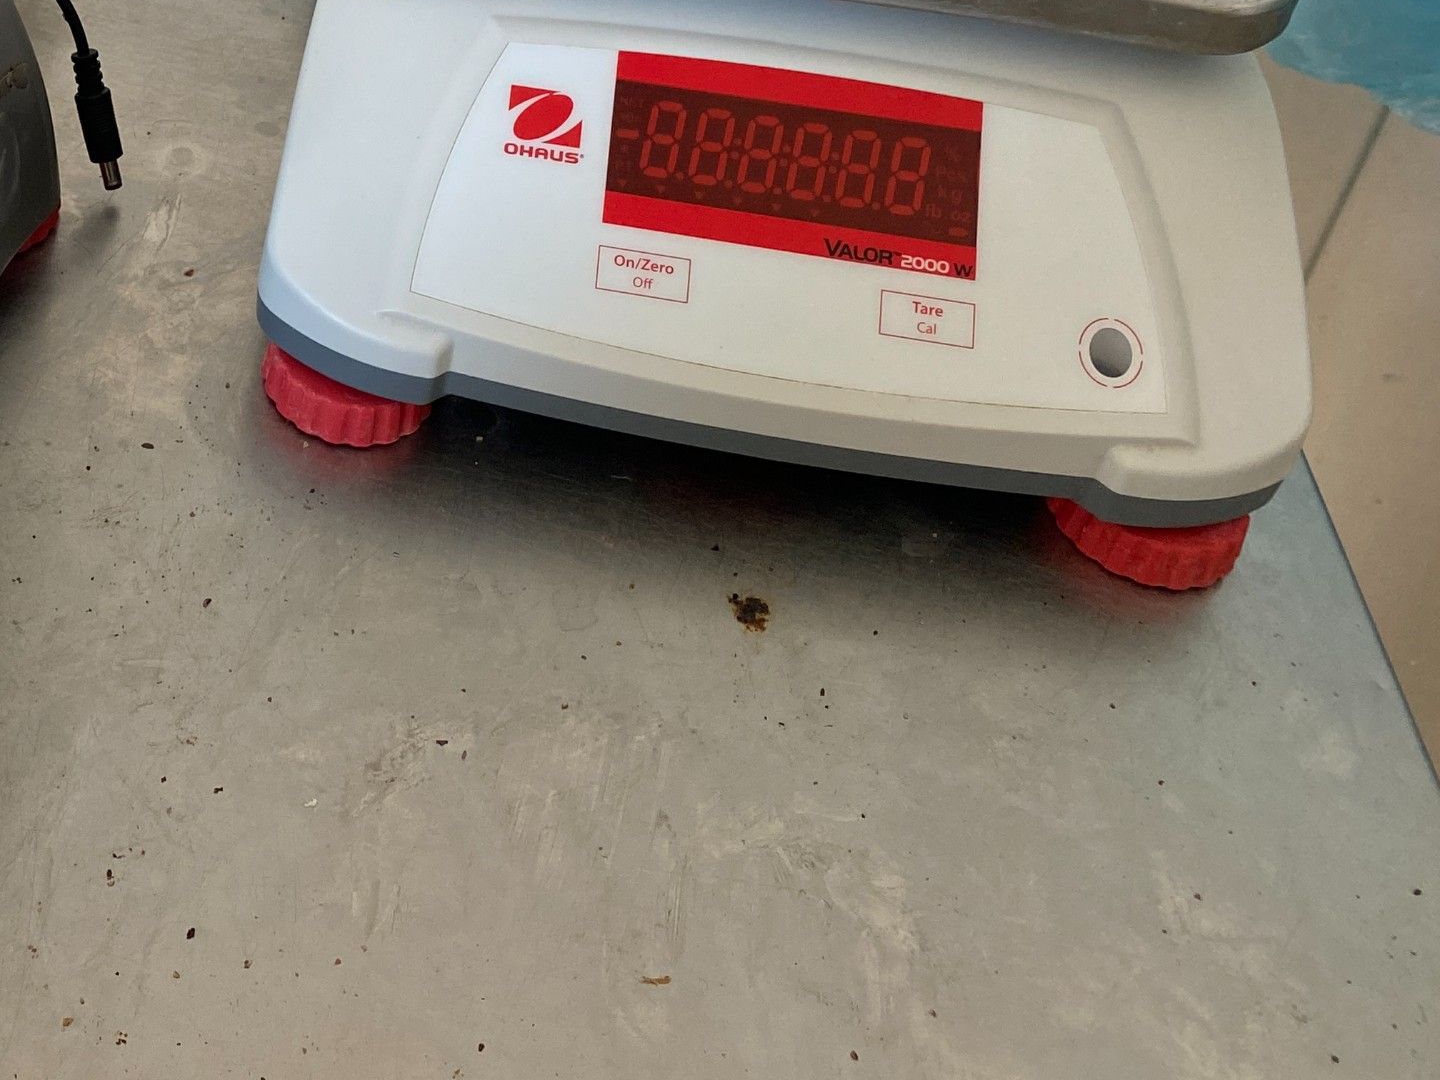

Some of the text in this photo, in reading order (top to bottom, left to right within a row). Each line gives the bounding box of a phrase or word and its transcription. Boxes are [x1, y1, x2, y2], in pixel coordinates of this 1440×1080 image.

[503, 142, 579, 164] OHAUS
[613, 254, 675, 276] On/Zero
[900, 253, 951, 275] 2000
[954, 262, 974, 278] W
[632, 276, 654, 290] Off
[911, 301, 944, 318] Tare
[916, 321, 937, 335] Cal
